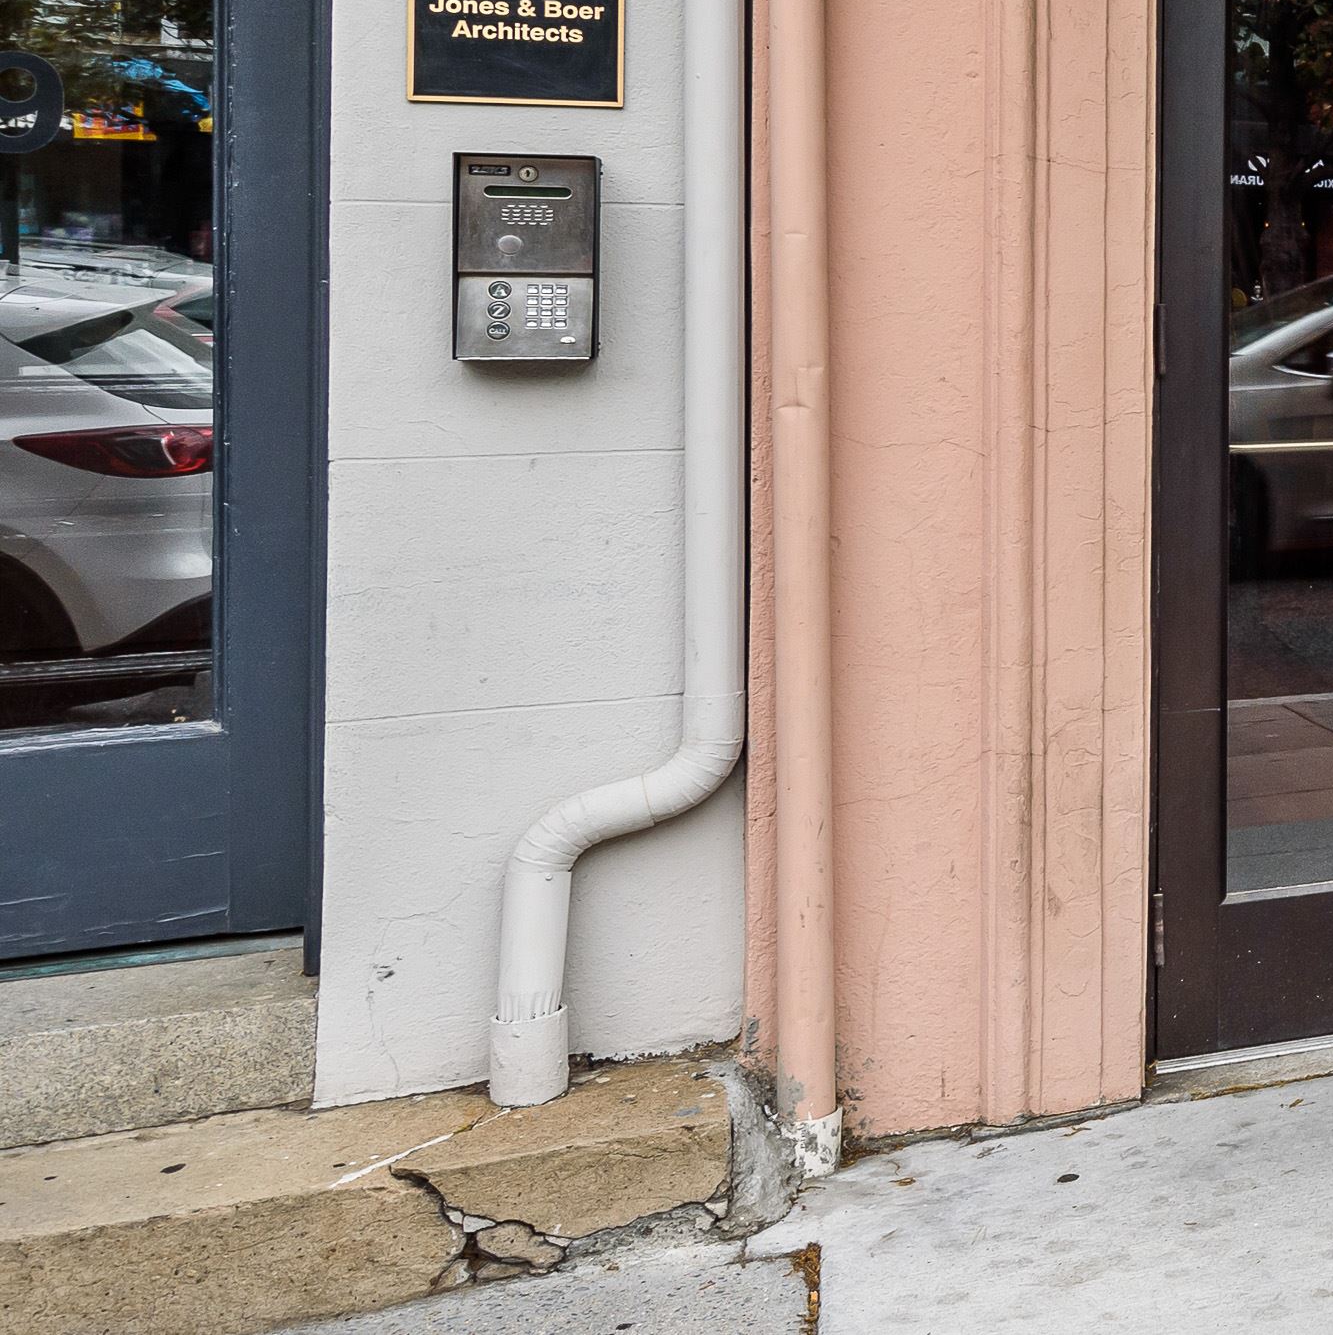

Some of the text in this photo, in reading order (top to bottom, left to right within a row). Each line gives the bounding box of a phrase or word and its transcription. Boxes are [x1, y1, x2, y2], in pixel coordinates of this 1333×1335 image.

[544, 0, 605, 21] Boer
[452, 19, 584, 44] Architects
[0, 50, 65, 154] 9
[491, 284, 508, 297] A
[490, 304, 506, 318] Z
